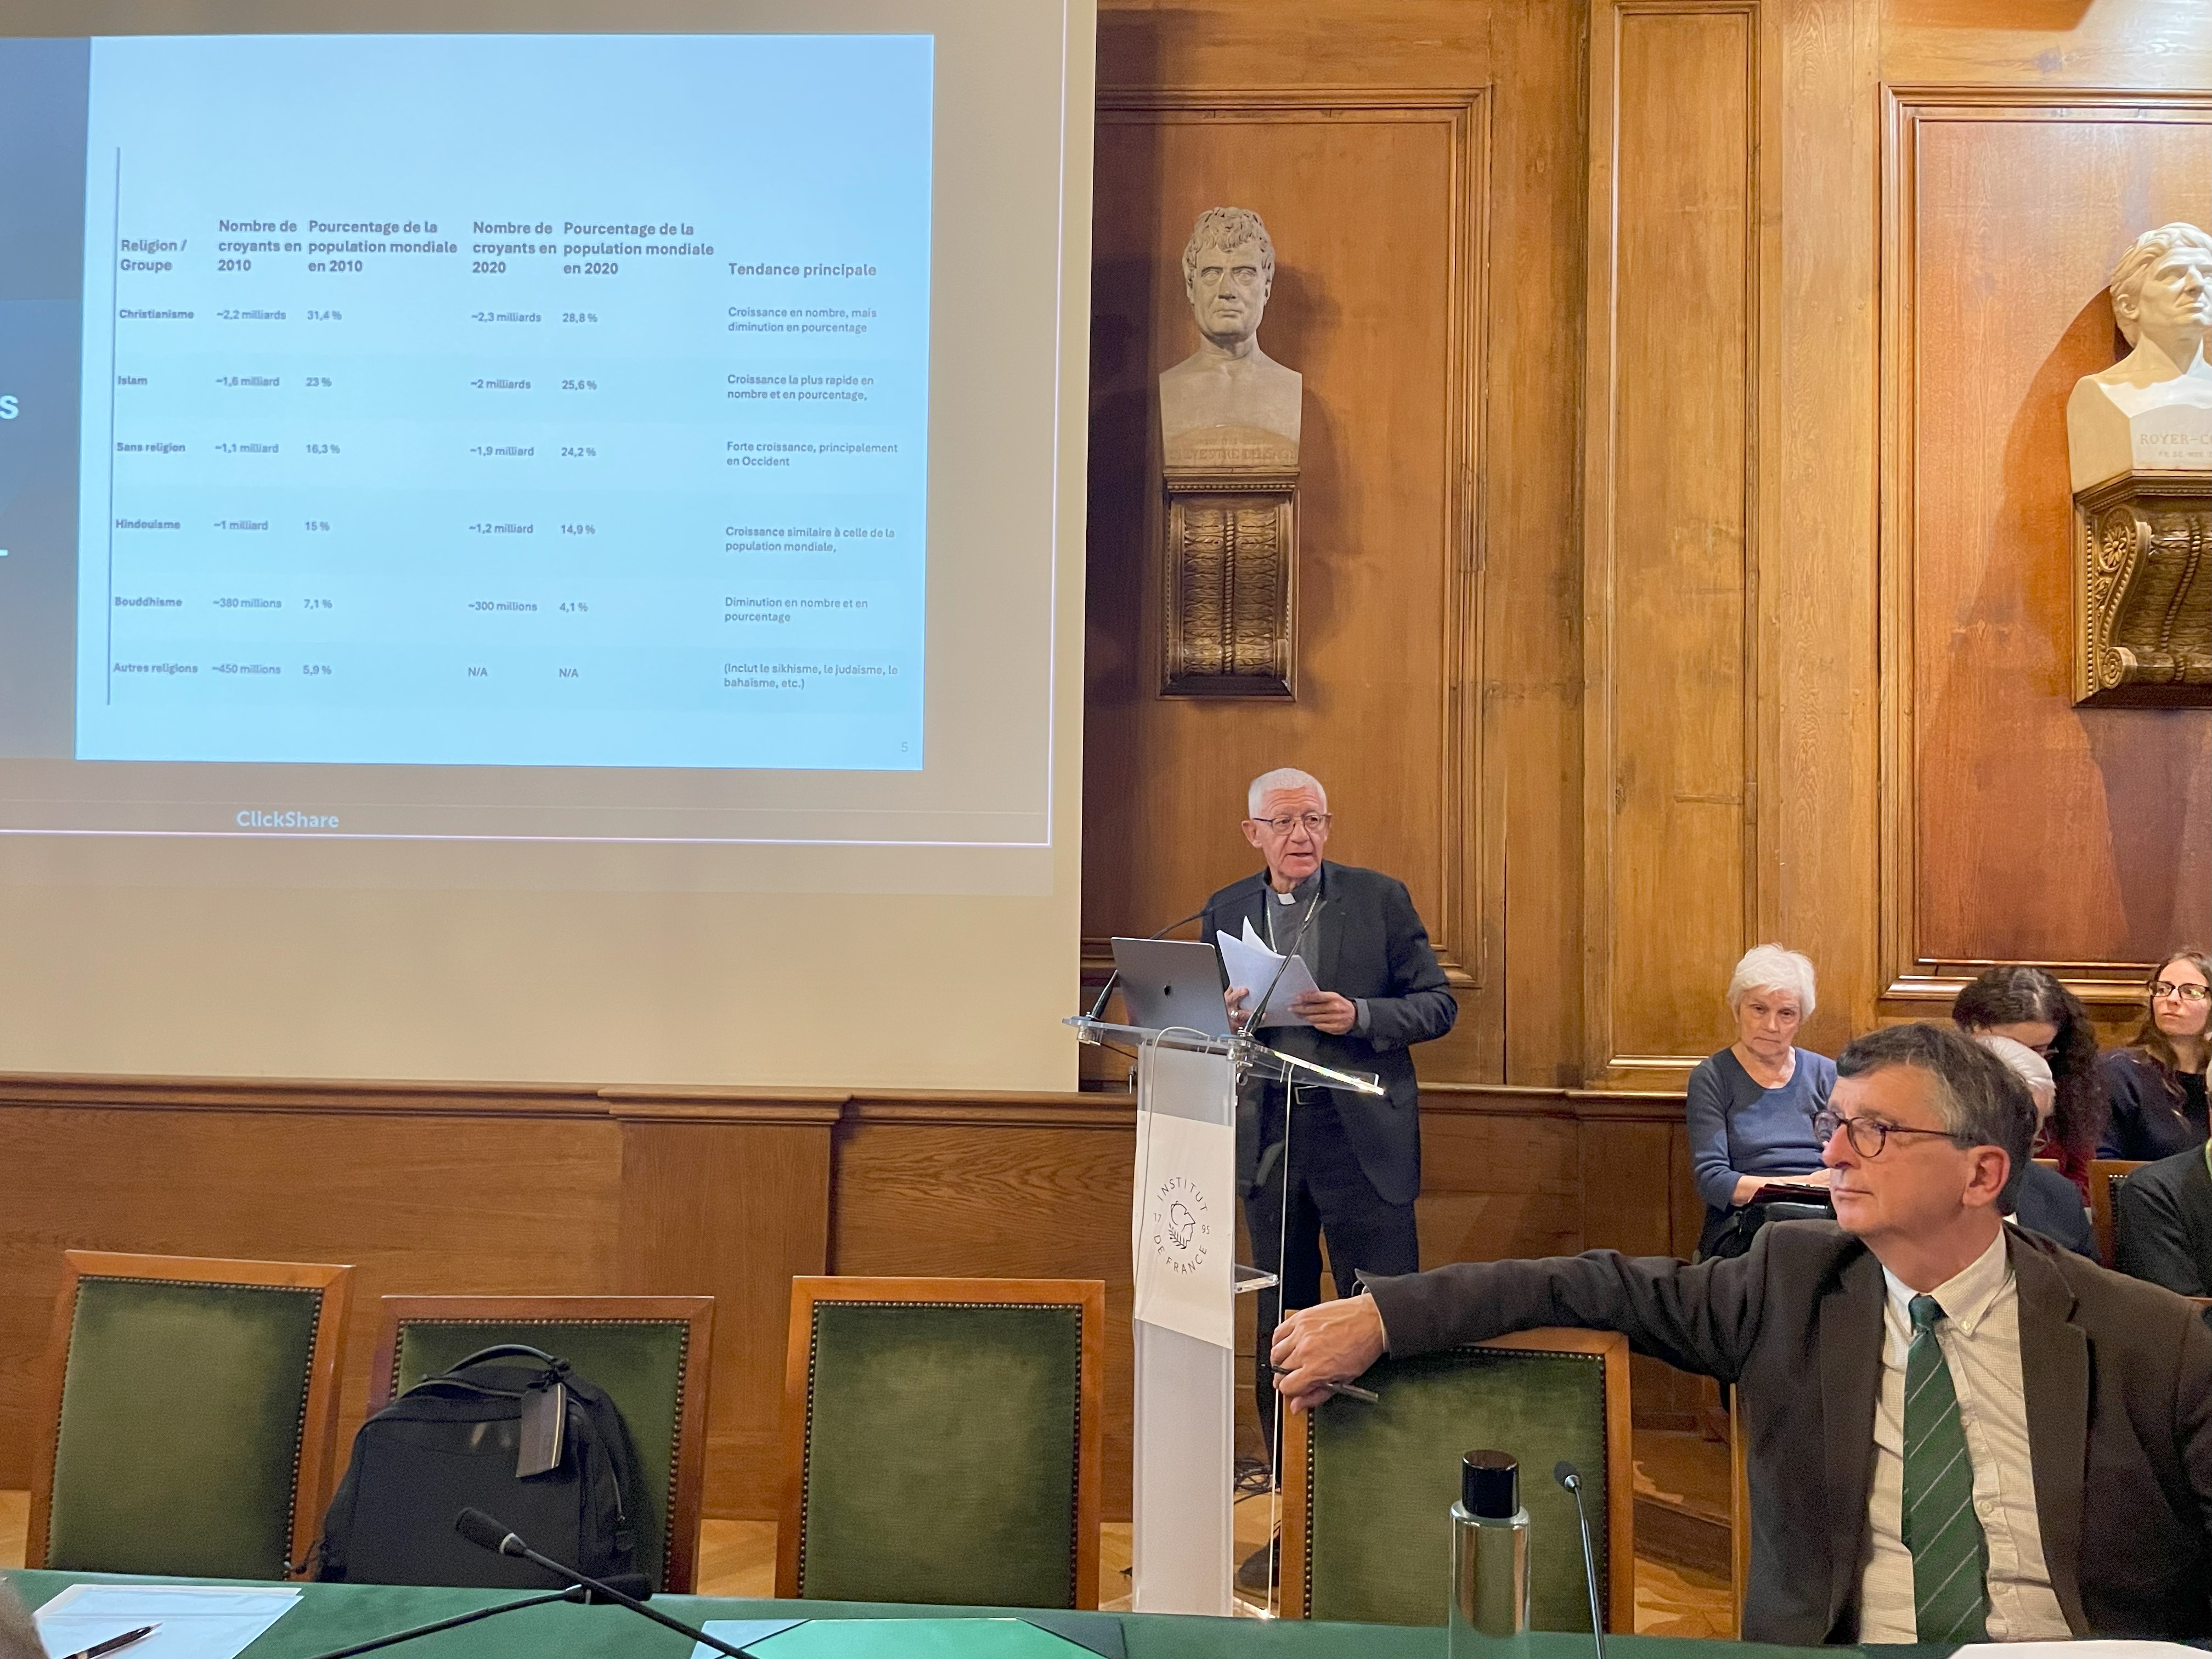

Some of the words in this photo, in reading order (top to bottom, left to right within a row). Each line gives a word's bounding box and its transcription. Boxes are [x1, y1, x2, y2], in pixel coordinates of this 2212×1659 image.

[219, 219, 276, 233] Nombre
[279, 219, 298, 233] de
[309, 219, 399, 236] Pourcentage
[403, 221, 421, 233] de
[424, 220, 438, 234] la
[473, 221, 531, 234] Nombre
[534, 221, 553, 234] de
[564, 222, 656, 238] Pourcentage
[659, 222, 678, 235] de
[681, 222, 694, 235] la
[121, 239, 178, 255] Religion
[180, 239, 188, 252] /
[218, 240, 281, 255] croyants
[284, 242, 302, 252] en
[308, 239, 386, 256] population
[390, 241, 458, 253] mondiale
[472, 242, 536, 257] croyants
[539, 245, 557, 255] en
[563, 241, 642, 258] population
[646, 242, 714, 256] mondiale
[120, 258, 173, 274] Groupe
[217, 259, 251, 272] 2010
[308, 262, 326, 272] en
[329, 259, 363, 273] 2010
[472, 261, 506, 274] 2020
[563, 264, 581, 274] en
[584, 262, 619, 274] 2020
[728, 262, 800, 275] Tendance
[803, 263, 876, 279] principale
[119, 308, 194, 319] Christianisme
[241, 309, 286, 320] milliards
[307, 310, 330, 321] 31,4
[331, 310, 342, 321] %
[496, 312, 542, 323] milliards
[728, 306, 787, 317] Croissance
[851, 307, 877, 318] mais
[562, 312, 585, 324] 28,8
[587, 313, 598, 323] %
[728, 321, 784, 332] diminution
[802, 324, 867, 335] pourcentage
[117, 375, 148, 386] Islam
[240, 376, 280, 387] milliard
[306, 377, 320, 387] 23
[320, 377, 332, 387] %
[486, 379, 531, 390] milliards
[561, 380, 585, 391] 25,6
[586, 380, 597, 391] %
[727, 374, 787, 385] Croissance
[789, 375, 799, 385] la
[800, 375, 823, 387] plus
[825, 375, 859, 387] rapide
[727, 389, 768, 399] nombre
[770, 390, 781, 399] et
[782, 391, 796, 399] en
[2140, 433, 2212, 444] ROYER-C
[116, 442, 144, 453] Sans
[145, 442, 186, 454] religion
[239, 443, 279, 453] milliard
[330, 444, 341, 454] %
[494, 446, 534, 456] milliard
[561, 447, 584, 458] 24,2
[586, 447, 597, 456] %
[727, 441, 754, 452] Forte
[819, 442, 898, 454] principalement
[742, 456, 789, 466] Occident
[115, 518, 180, 529] Hindouisme
[229, 520, 269, 531] milliard
[305, 521, 318, 531] 15
[319, 521, 330, 532] %
[494, 523, 534, 534] milliard
[561, 524, 584, 535] 14,9
[585, 524, 596, 534] %
[726, 526, 785, 537] Croissance
[787, 526, 832, 537] similaire
[834, 527, 840, 537] à
[843, 528, 868, 538] celle
[870, 528, 883, 538] de
[885, 528, 895, 538] la
[726, 541, 782, 553] population
[115, 596, 183, 607] Bouddhisme
[240, 598, 282, 609] millions
[303, 599, 319, 610] 7,1
[322, 599, 333, 609] %
[496, 602, 538, 611] millions
[559, 601, 575, 613] 4,1
[578, 602, 588, 612] %
[725, 596, 782, 607] Diminution
[800, 597, 840, 608] nombre
[843, 600, 853, 608] et
[725, 613, 791, 624] pourcentage
[113, 663, 149, 673] Autres
[151, 663, 199, 675] religions
[240, 664, 281, 674] millions
[303, 665, 319, 676] 5,9
[321, 665, 332, 675] %
[468, 667, 488, 678] N/A
[558, 668, 579, 678] N/A
[724, 663, 758, 675] (Inclut
[760, 663, 770, 673] le
[823, 664, 833, 674] le
[888, 664, 898, 675] le
[781, 678, 805, 690] etc.)
[901, 742, 909, 753] 5
[236, 810, 339, 827] ClickShare
[1157, 1177, 1208, 1211] INSTITUT
[1154, 1212, 1162, 1223] 17
[1201, 1224, 1210, 1234] 95
[1154, 1235, 1165, 1255] DE
[1166, 1245, 1207, 1274] FRANCE
